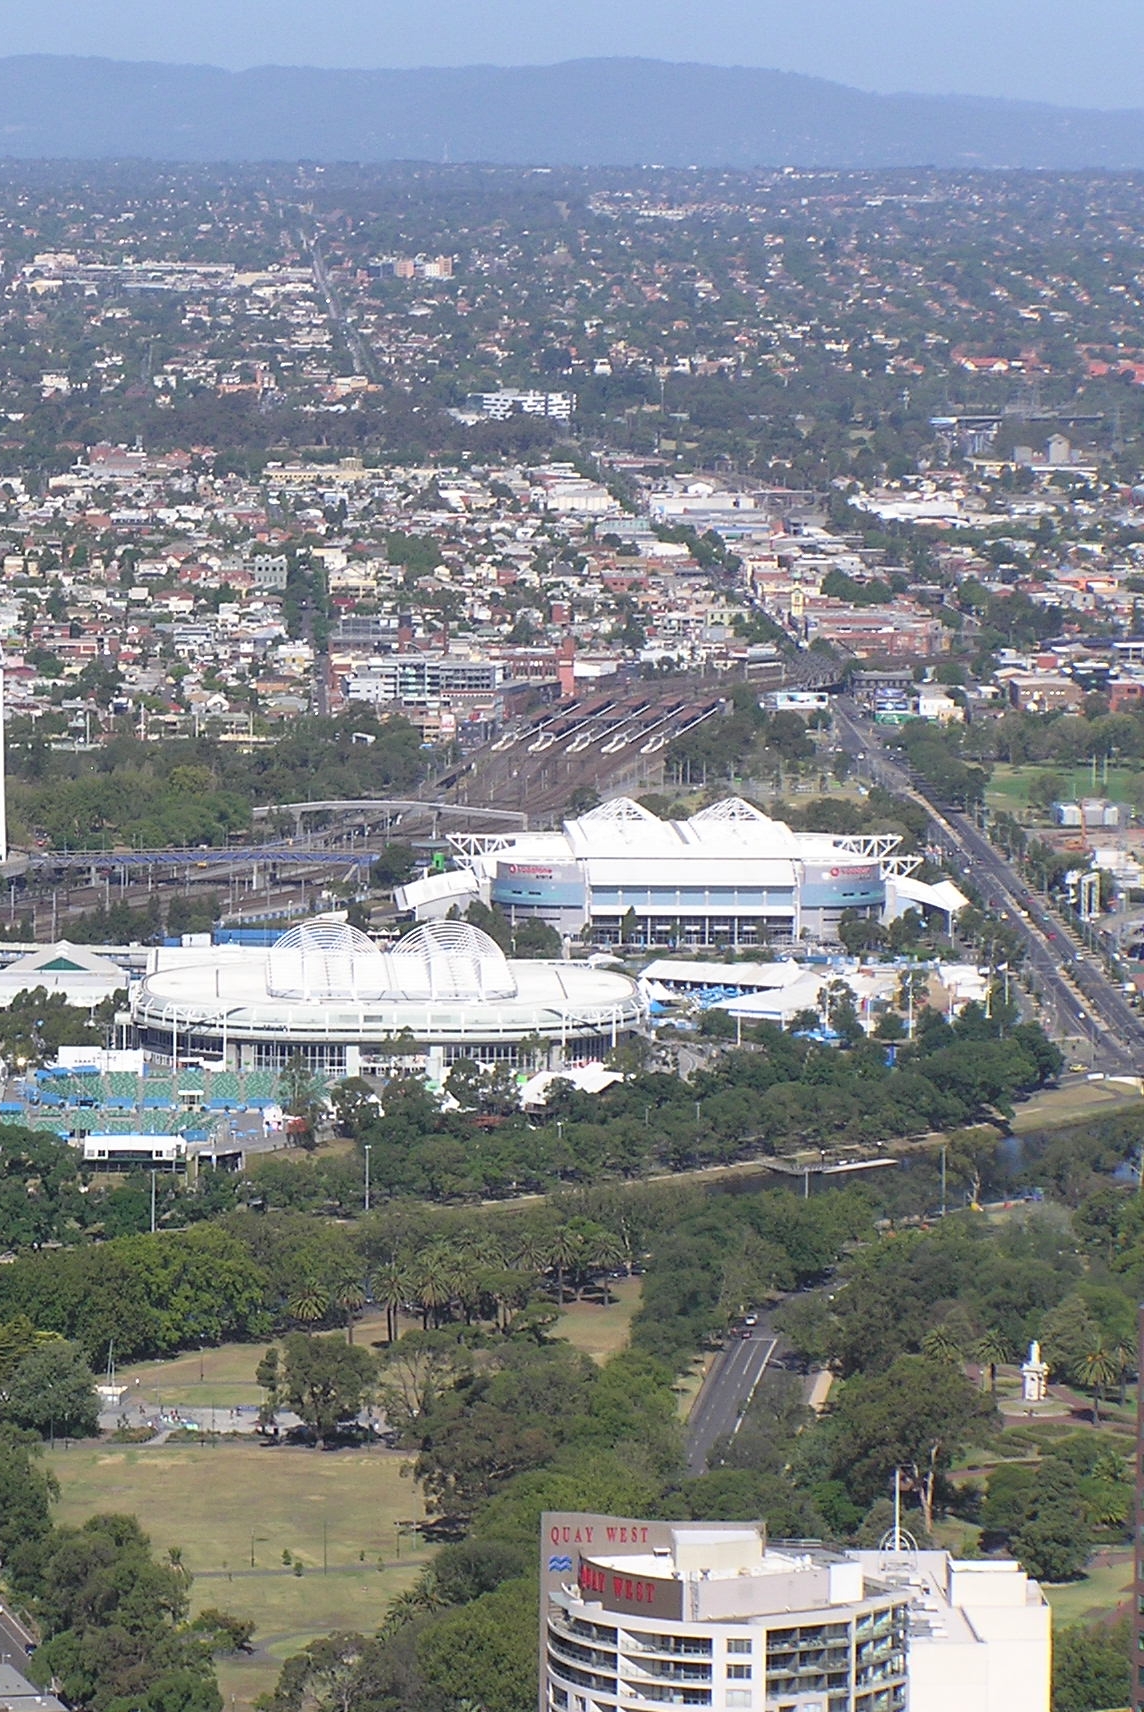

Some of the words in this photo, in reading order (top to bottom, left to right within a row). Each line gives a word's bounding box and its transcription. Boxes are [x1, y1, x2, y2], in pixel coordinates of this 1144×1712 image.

[550, 1526, 594, 1546] QUAY
[606, 1526, 649, 1543] WEST
[613, 1576, 655, 1603] WEST
